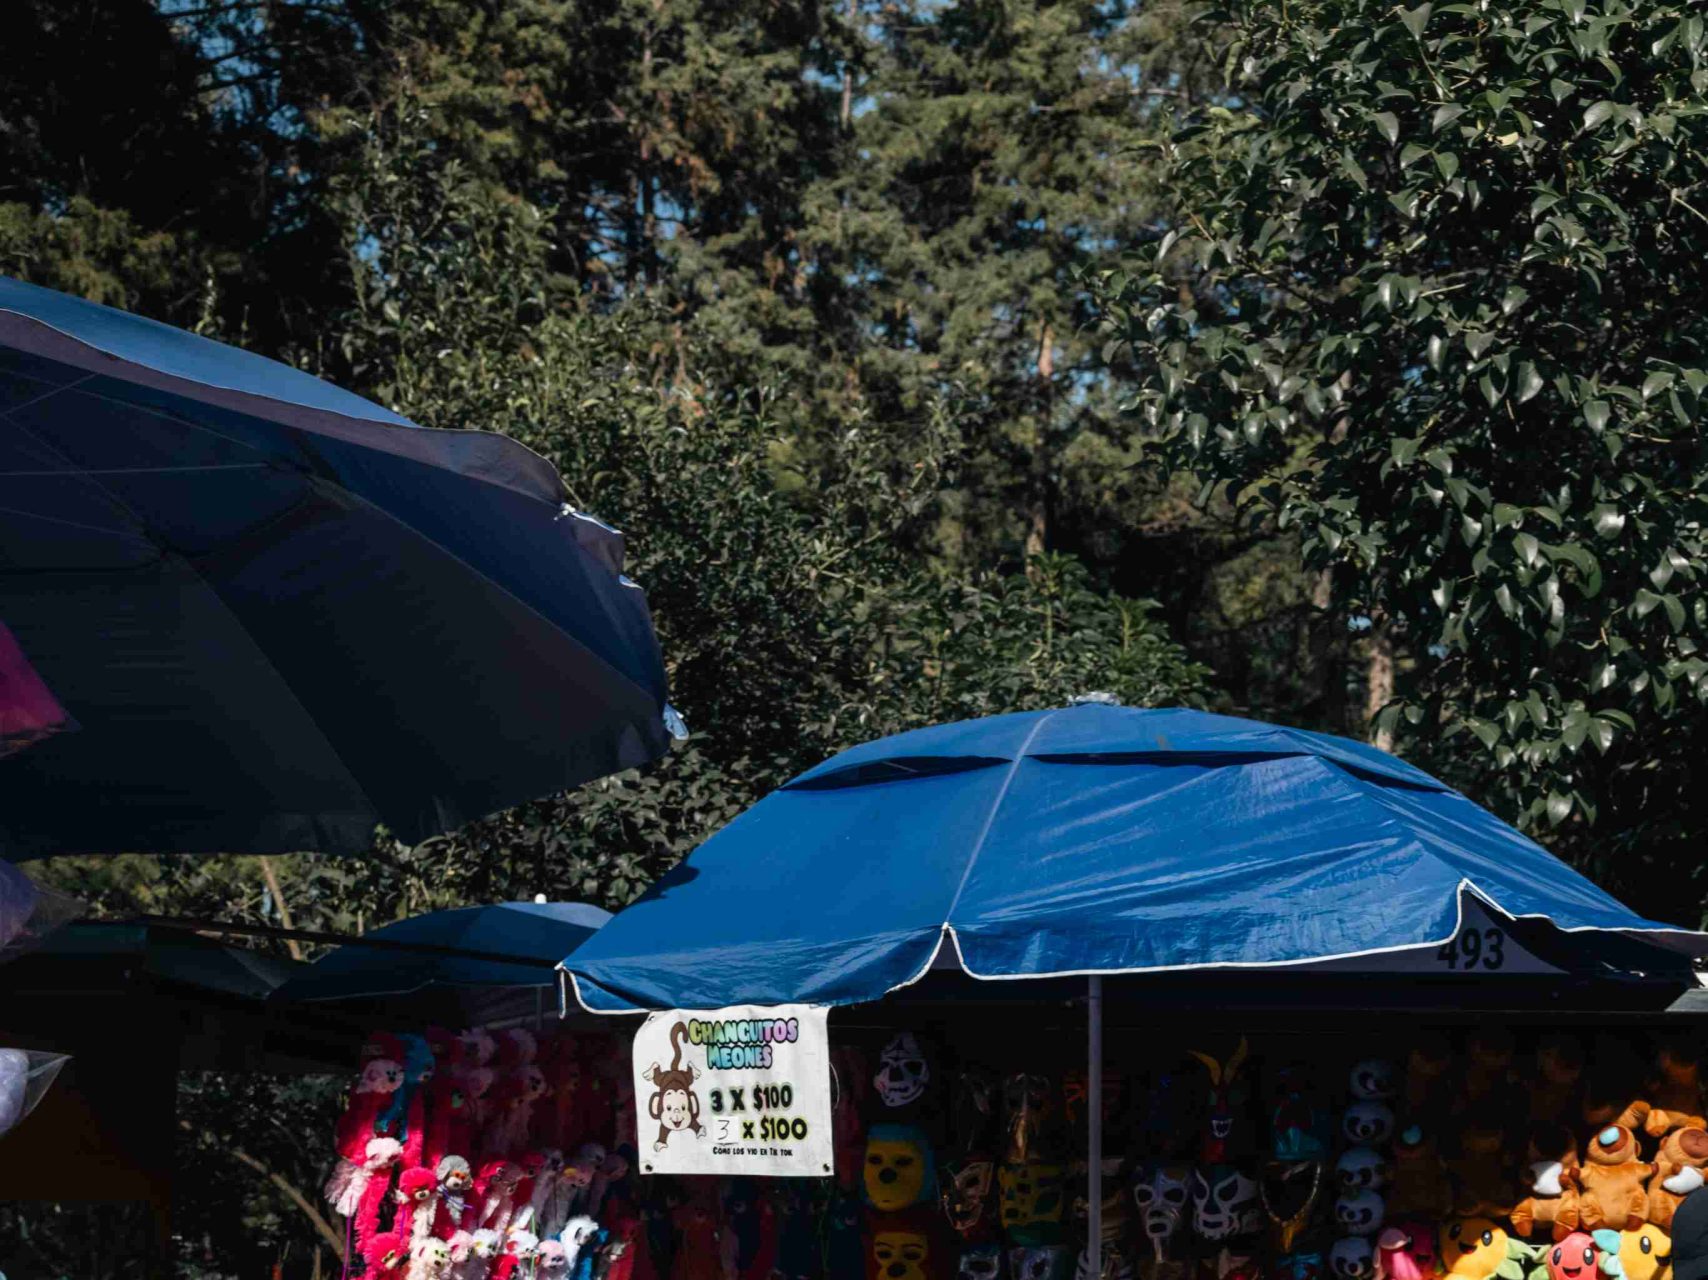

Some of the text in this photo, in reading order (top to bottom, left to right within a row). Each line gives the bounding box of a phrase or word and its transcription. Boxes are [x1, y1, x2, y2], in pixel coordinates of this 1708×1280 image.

[1437, 927, 1504, 970] 493
[688, 1017, 799, 1045] CHANGUITOS
[707, 1044, 773, 1070] MEONES
[711, 1090, 723, 1112] 3
[754, 1084, 792, 1111] $100
[717, 1119, 730, 1140] 3
[761, 1116, 807, 1141] $100
